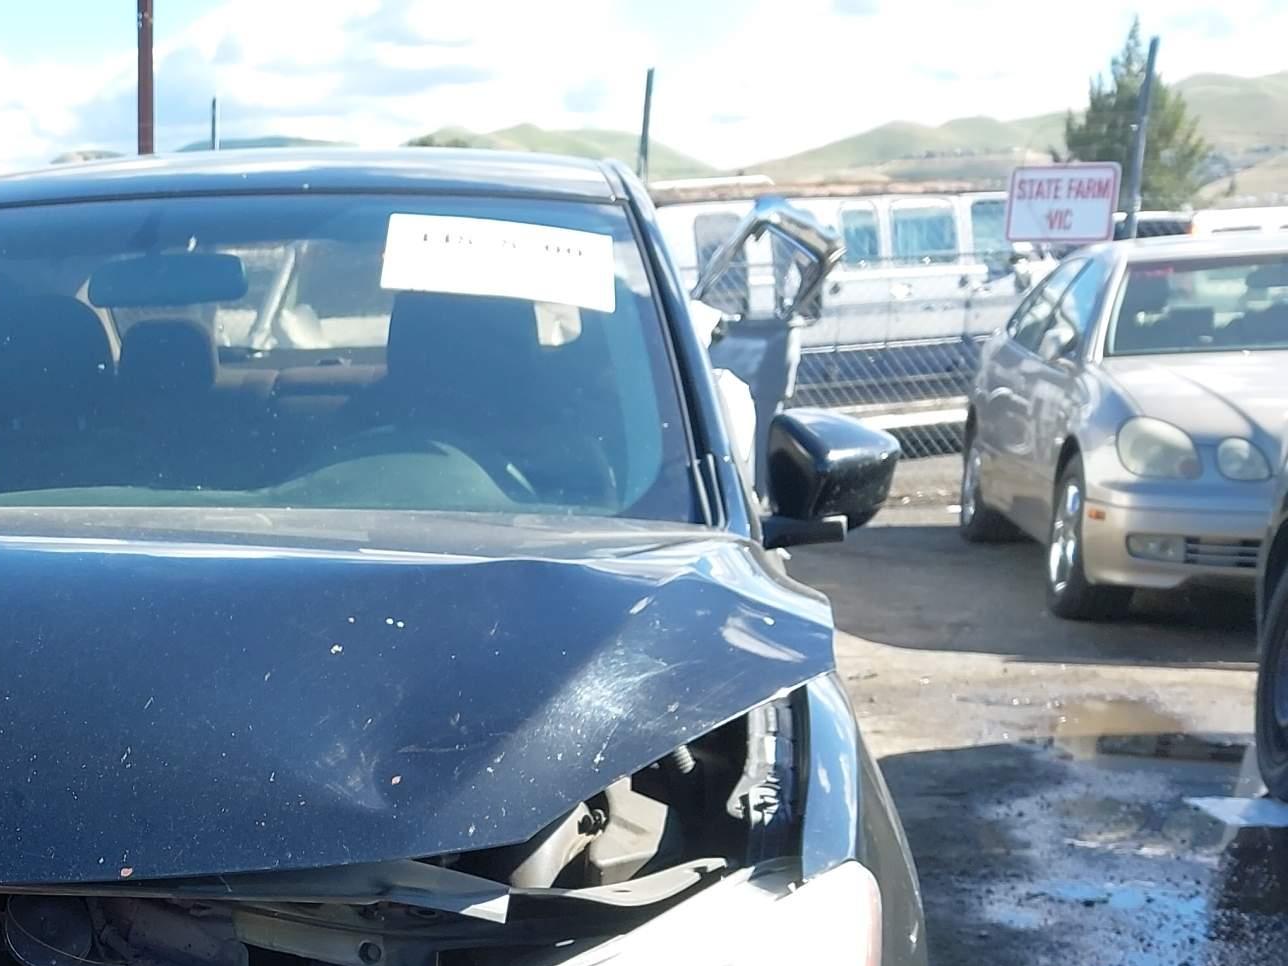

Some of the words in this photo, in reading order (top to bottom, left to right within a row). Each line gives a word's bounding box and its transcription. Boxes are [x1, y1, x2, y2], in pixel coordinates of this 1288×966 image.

[1017, 178, 1062, 199] STATE
[1066, 178, 1112, 199] FARM
[1046, 208, 1073, 231] VIC
